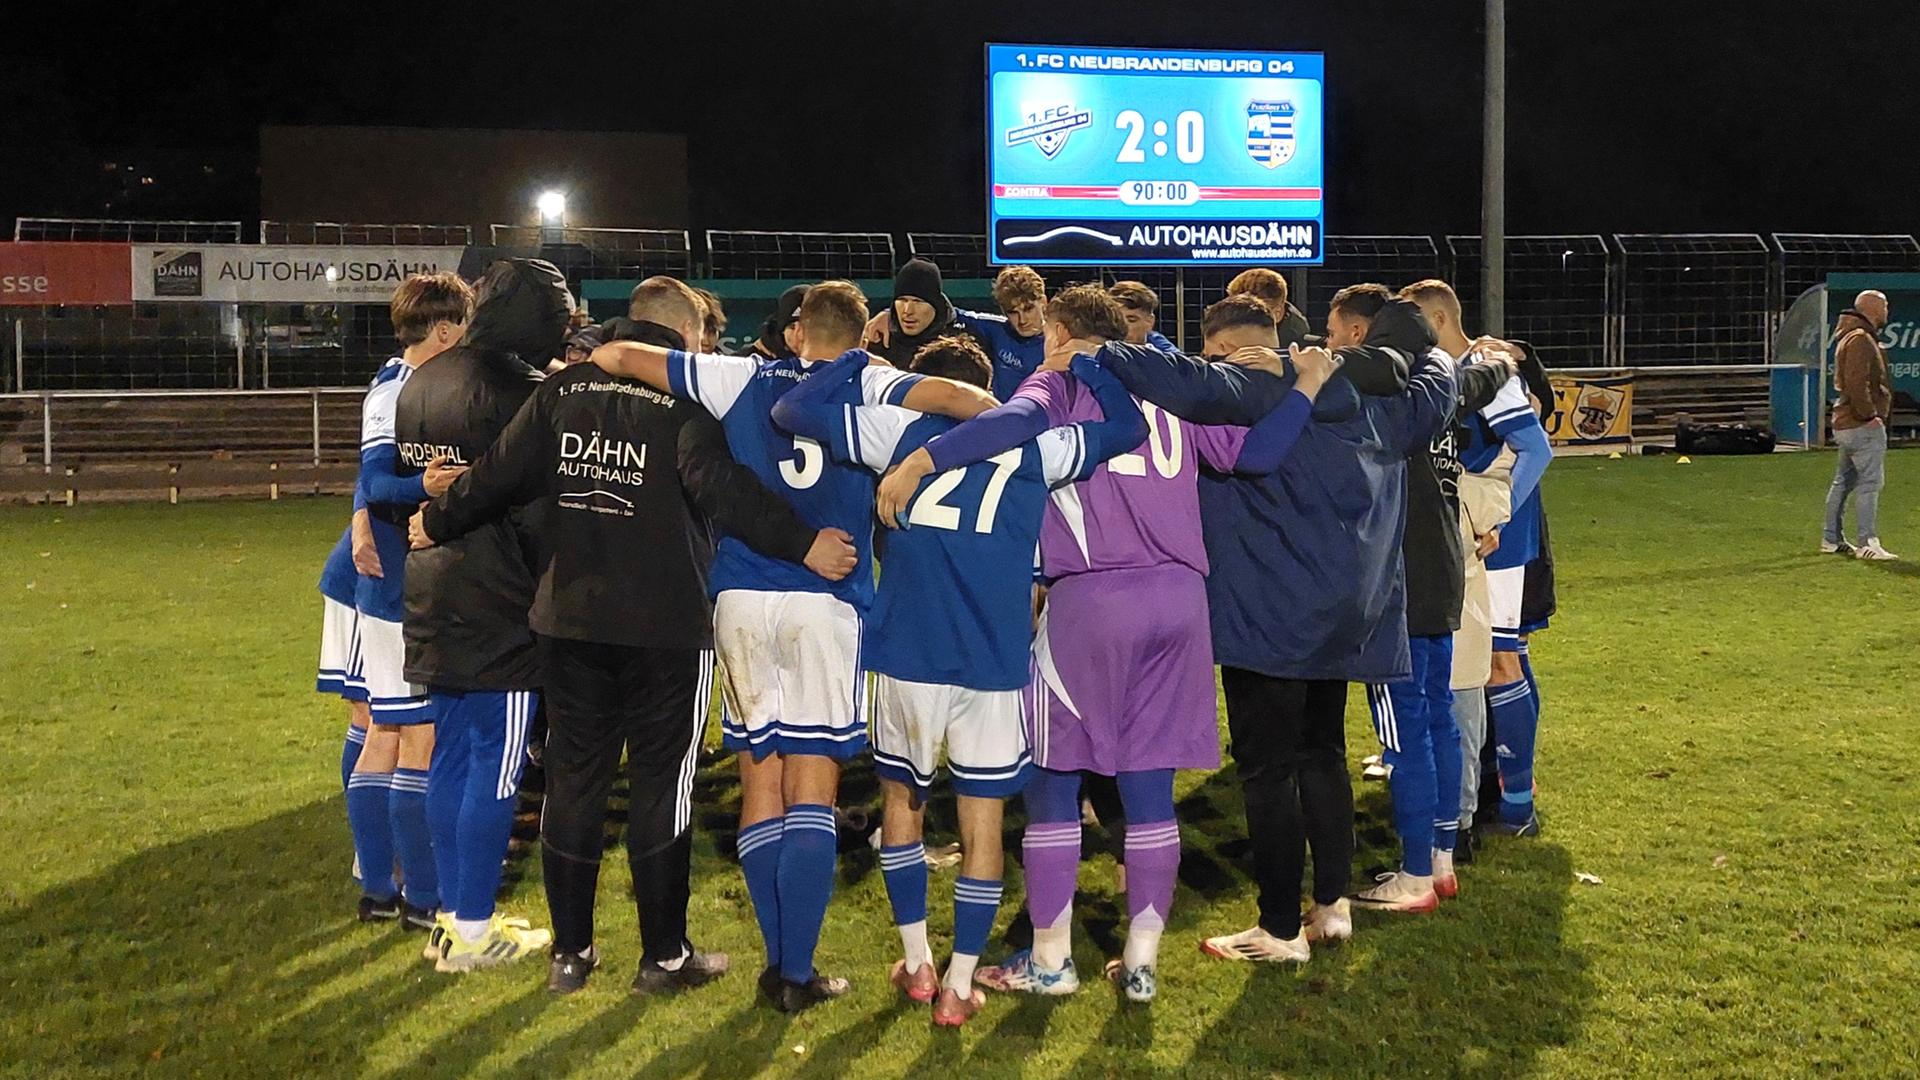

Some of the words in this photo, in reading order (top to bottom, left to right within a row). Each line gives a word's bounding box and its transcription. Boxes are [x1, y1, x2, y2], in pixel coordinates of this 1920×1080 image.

[1070, 55, 1262, 73] NEUBRANDENBURG
[1267, 60, 1295, 74] 04
[1133, 182, 1187, 200] 90:00
[1128, 222, 1312, 246] AUTOHAUSDÄHN
[1192, 247, 1312, 259] www.autohausdaehn.de
[570, 382, 587, 394] FC
[661, 395, 676, 409] 04
[560, 430, 647, 469] DÄHN
[556, 460, 644, 486] AUTOHAUS
[908, 434, 1024, 535] 27
